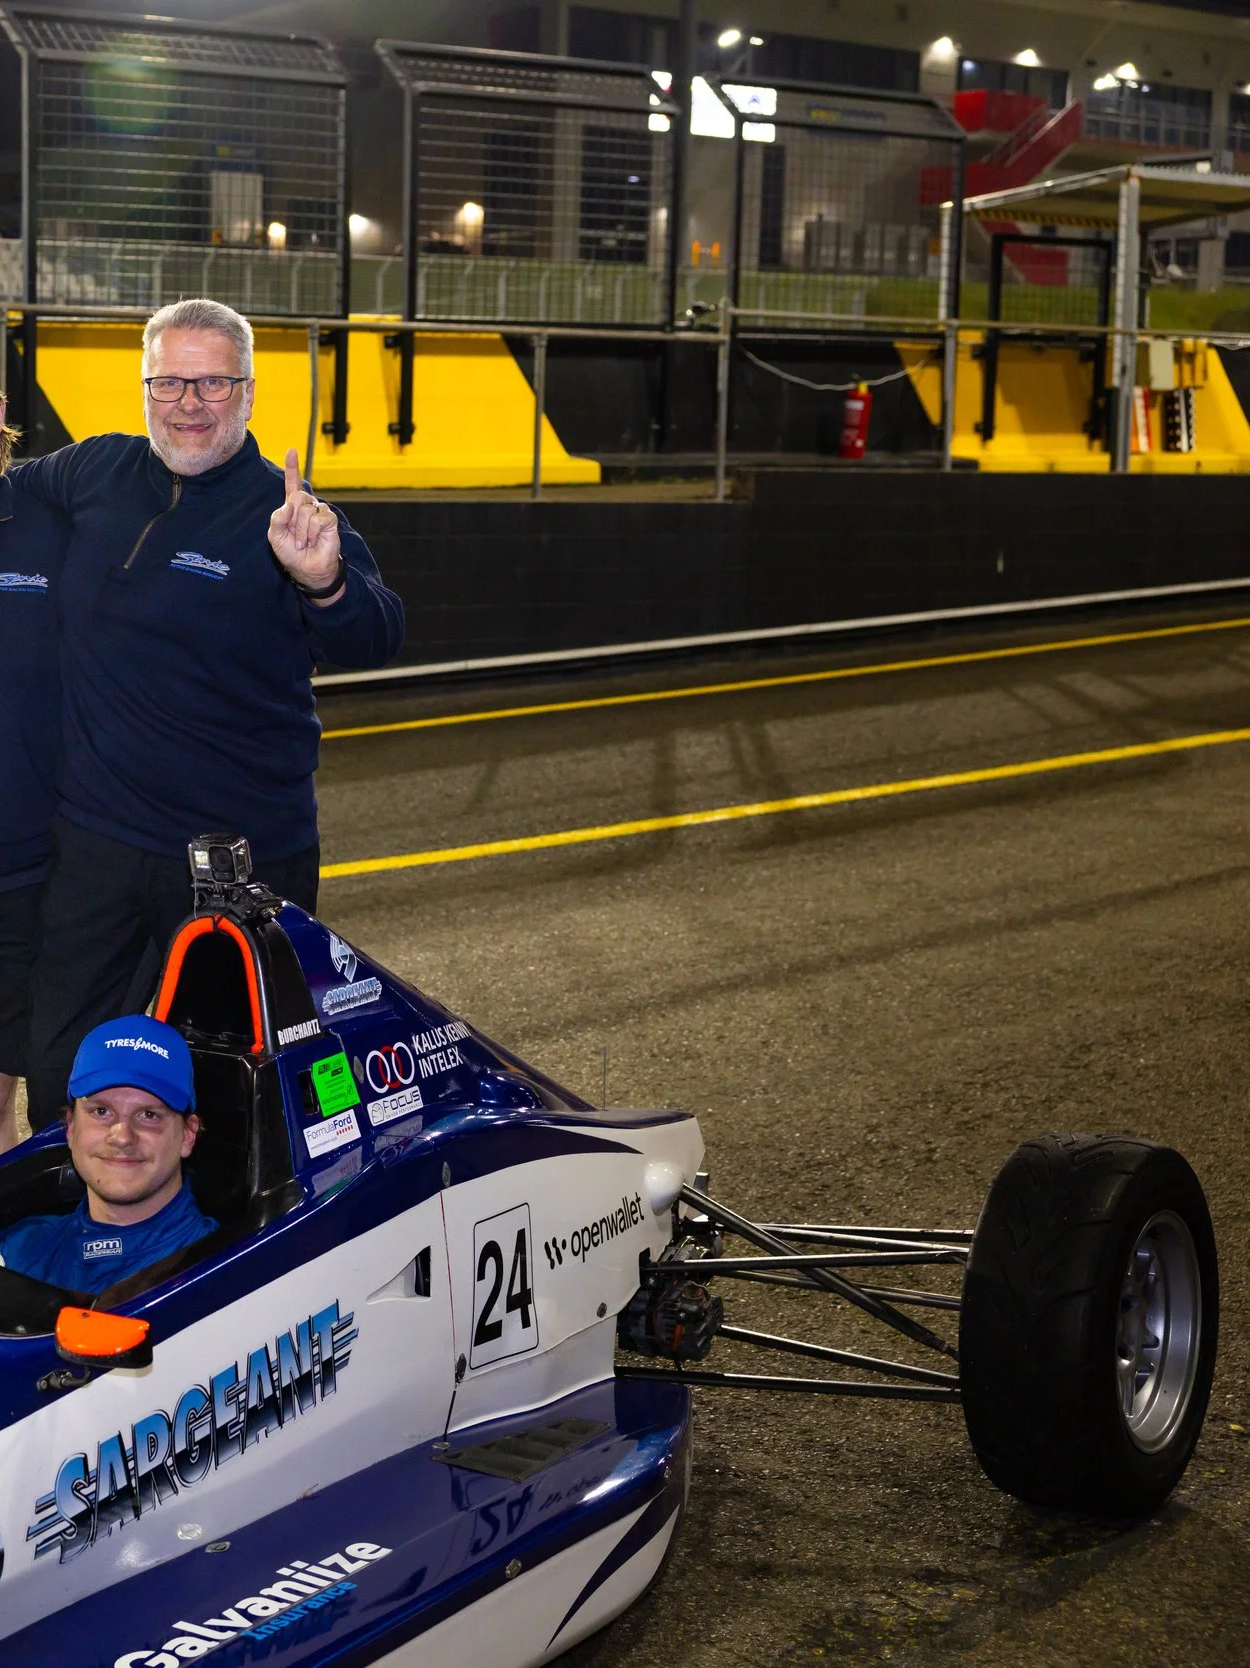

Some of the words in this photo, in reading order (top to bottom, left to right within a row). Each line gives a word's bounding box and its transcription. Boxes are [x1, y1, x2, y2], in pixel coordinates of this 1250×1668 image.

[412, 1027, 447, 1055] KALUS
[418, 1046, 464, 1079] INTELEX
[383, 1089, 421, 1114] FOCUS
[306, 1114, 352, 1141] FormulaFord
[87, 1240, 120, 1252] rpm
[571, 1191, 644, 1263] openwallet
[473, 1228, 532, 1347] 24
[40, 1299, 350, 1564] SARGEANT
[114, 1542, 393, 1668] Galvaniize
[241, 1580, 358, 1641] Insurance
